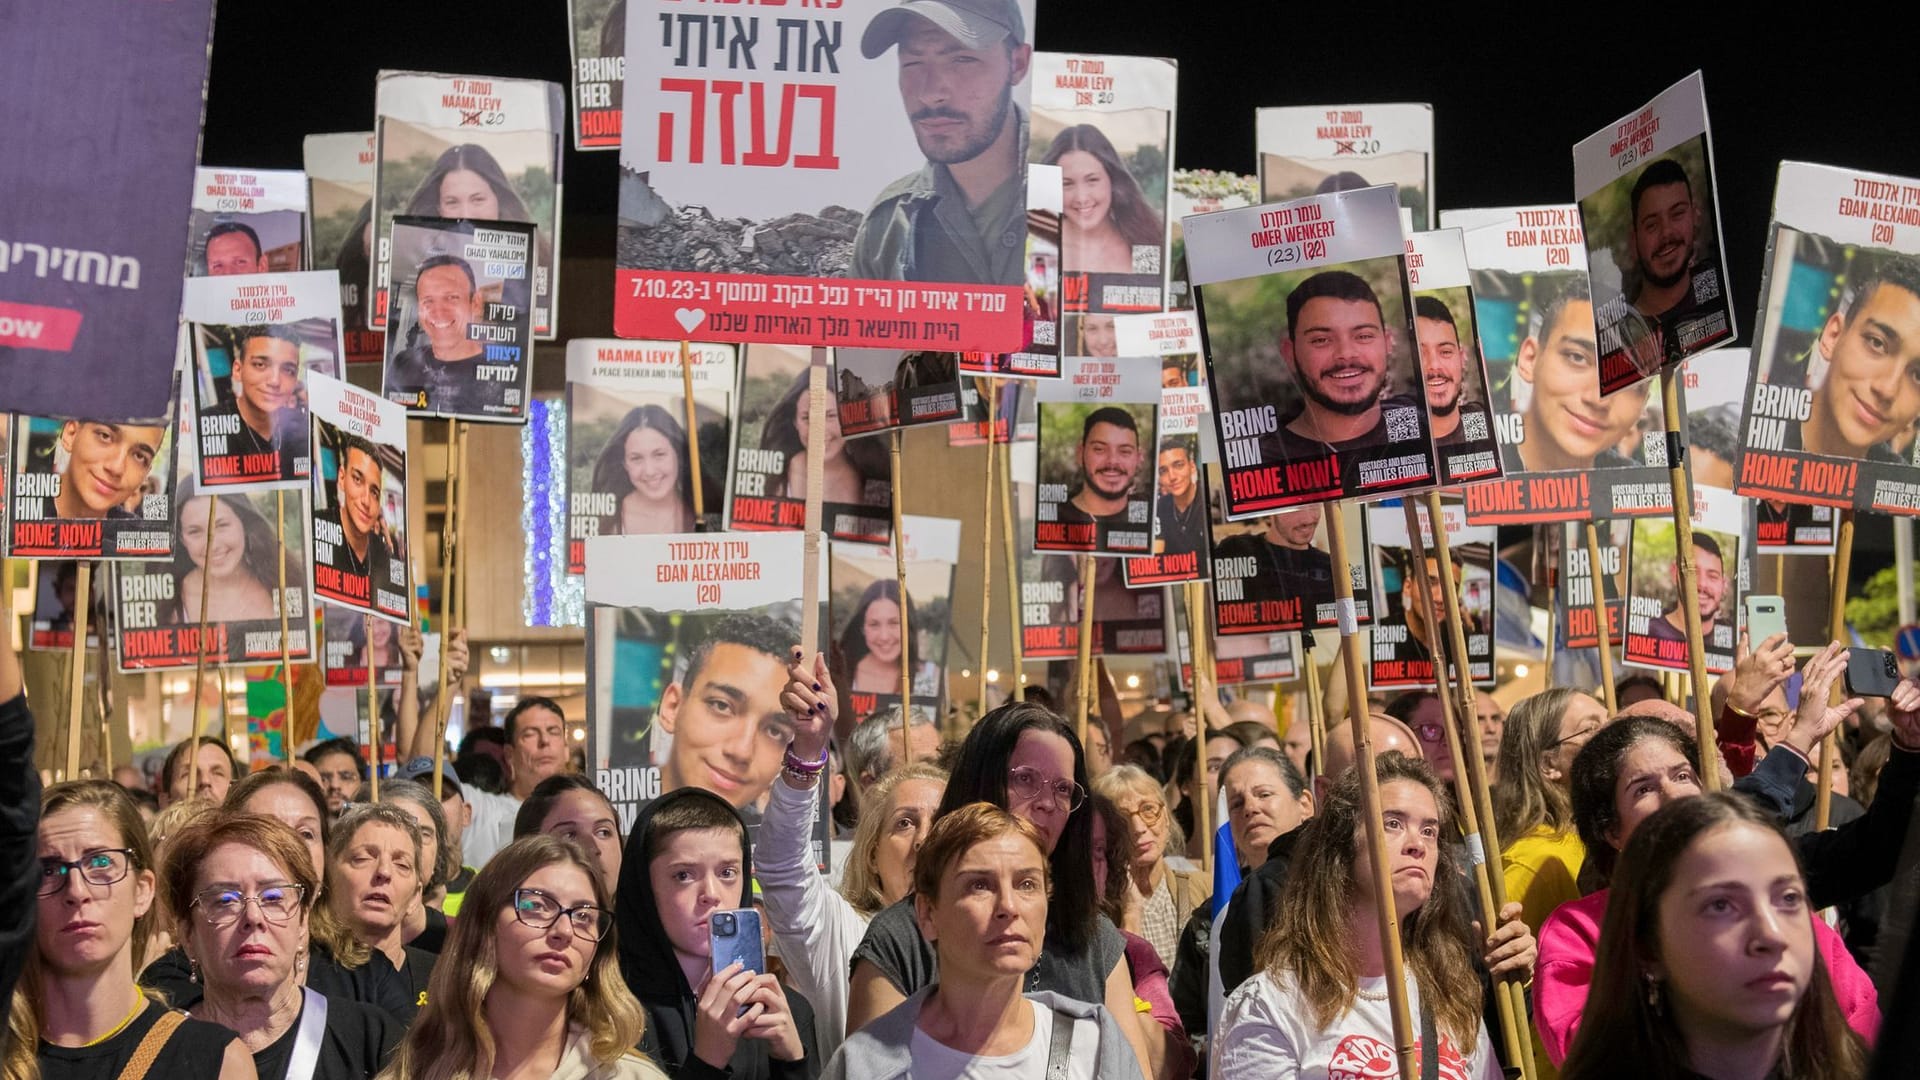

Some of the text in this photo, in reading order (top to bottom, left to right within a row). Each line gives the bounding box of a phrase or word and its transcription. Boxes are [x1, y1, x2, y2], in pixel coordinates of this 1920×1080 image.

[659, 12, 842, 74] את איתי
[579, 57, 625, 83] BRING
[1056, 75, 1114, 90] NAAMA LEVY
[442, 95, 501, 111] NAAMA LEVY
[580, 82, 612, 108] HER
[581, 111, 622, 137] HOM
[657, 78, 840, 170] בעזה
[1317, 126, 1372, 139] NAAMA LEVY
[1609, 117, 1660, 158] OMER WENKERT
[1617, 150, 1638, 171] (23)
[1854, 178, 1900, 203] אלכסנדר
[1260, 204, 1322, 229] עומר ונקרט
[1516, 209, 1566, 227] אלכסנדר
[1838, 198, 1920, 227] EDAN ALEXAND
[1251, 221, 1336, 248] OMER WENKERT
[1507, 228, 1584, 247] EDAN ALEXAN
[1872, 223, 1894, 245] (20)
[1267, 248, 1301, 267] (23)
[1546, 248, 1570, 265] (20)
[231, 297, 295, 310] EDAN ALEXANDER
[716, 282, 767, 305] ונחטף
[772, 283, 813, 308] בקרב
[818, 283, 849, 305] נפל
[897, 289, 916, 312] חן
[921, 289, 958, 310] איתי
[245, 311, 266, 322] (20)
[489, 303, 516, 320] פדיון
[1596, 293, 1628, 331] BRING
[471, 324, 516, 341] השבויים
[709, 312, 960, 341] היית ותישאר מלך האריות שלנו
[1679, 318, 1727, 348] FAMILIES FORUM
[1600, 326, 1623, 356] HIM
[598, 348, 643, 363] NAAMA
[646, 350, 675, 364] LEVY
[476, 364, 518, 382] למדינה
[1752, 383, 1813, 421] BRING
[201, 414, 240, 434] BRING
[338, 401, 381, 426] EDAN ALEXANDER
[1220, 405, 1277, 440] BRING
[1747, 416, 1787, 451] HIM
[203, 435, 228, 456] HIM
[1225, 437, 1262, 469] HIM
[204, 457, 240, 476] HOME
[243, 449, 281, 474] NOW!
[738, 448, 785, 474] BRING
[1359, 453, 1426, 471] HOSTAGES AND MISSING
[1449, 459, 1496, 476] FAMILIES FORUM
[16, 472, 62, 497] BRING
[735, 473, 766, 497] HER
[1230, 454, 1341, 500] HOME NOW!
[1360, 464, 1428, 485] FAMILIES FORUM
[1742, 453, 1858, 497] HOME NOW!
[1039, 484, 1067, 502] BRING
[1467, 472, 1590, 514] HOME NOW!
[1612, 484, 1644, 495] HOSTAGES
[1644, 483, 1657, 493] AND
[1873, 492, 1910, 507] FAMILIES
[15, 497, 44, 521] HIM
[571, 493, 616, 516] BRING
[734, 497, 775, 523] HOME
[1039, 503, 1058, 521] HIM
[1613, 495, 1654, 509] FAMILIES
[15, 520, 102, 547] HOME NOW!
[314, 518, 342, 546] BRING
[571, 517, 599, 538] HER
[1038, 523, 1066, 541] HOME
[1068, 523, 1096, 543] NOW!
[1758, 522, 1788, 539] NOW!
[117, 539, 170, 551] FAMILIES FORUM
[315, 541, 334, 565] HIM
[668, 541, 749, 561] עידן אלכסנדר
[656, 562, 760, 582] EDAN ALEXANDER
[1129, 551, 1198, 576] HOME NOW!
[1215, 556, 1257, 579] BRING
[121, 573, 175, 600] BRING
[315, 566, 370, 599] HOME NOW!
[1022, 582, 1064, 603] BRING
[1217, 579, 1244, 601] HIM
[696, 584, 721, 604] (20)
[122, 602, 157, 628] HER
[1023, 604, 1050, 625] HER
[1219, 602, 1259, 625] HOME
[1261, 597, 1303, 622] NOW!
[1631, 596, 1662, 618] BRING
[1374, 625, 1407, 643] BRING
[1629, 615, 1650, 635] HIM
[124, 629, 173, 657] HOME
[1024, 627, 1061, 648] HOME
[1628, 635, 1657, 657] HOME
[1374, 644, 1396, 661] HIM
[1375, 661, 1405, 679] HOME
[597, 767, 661, 801] BRING
